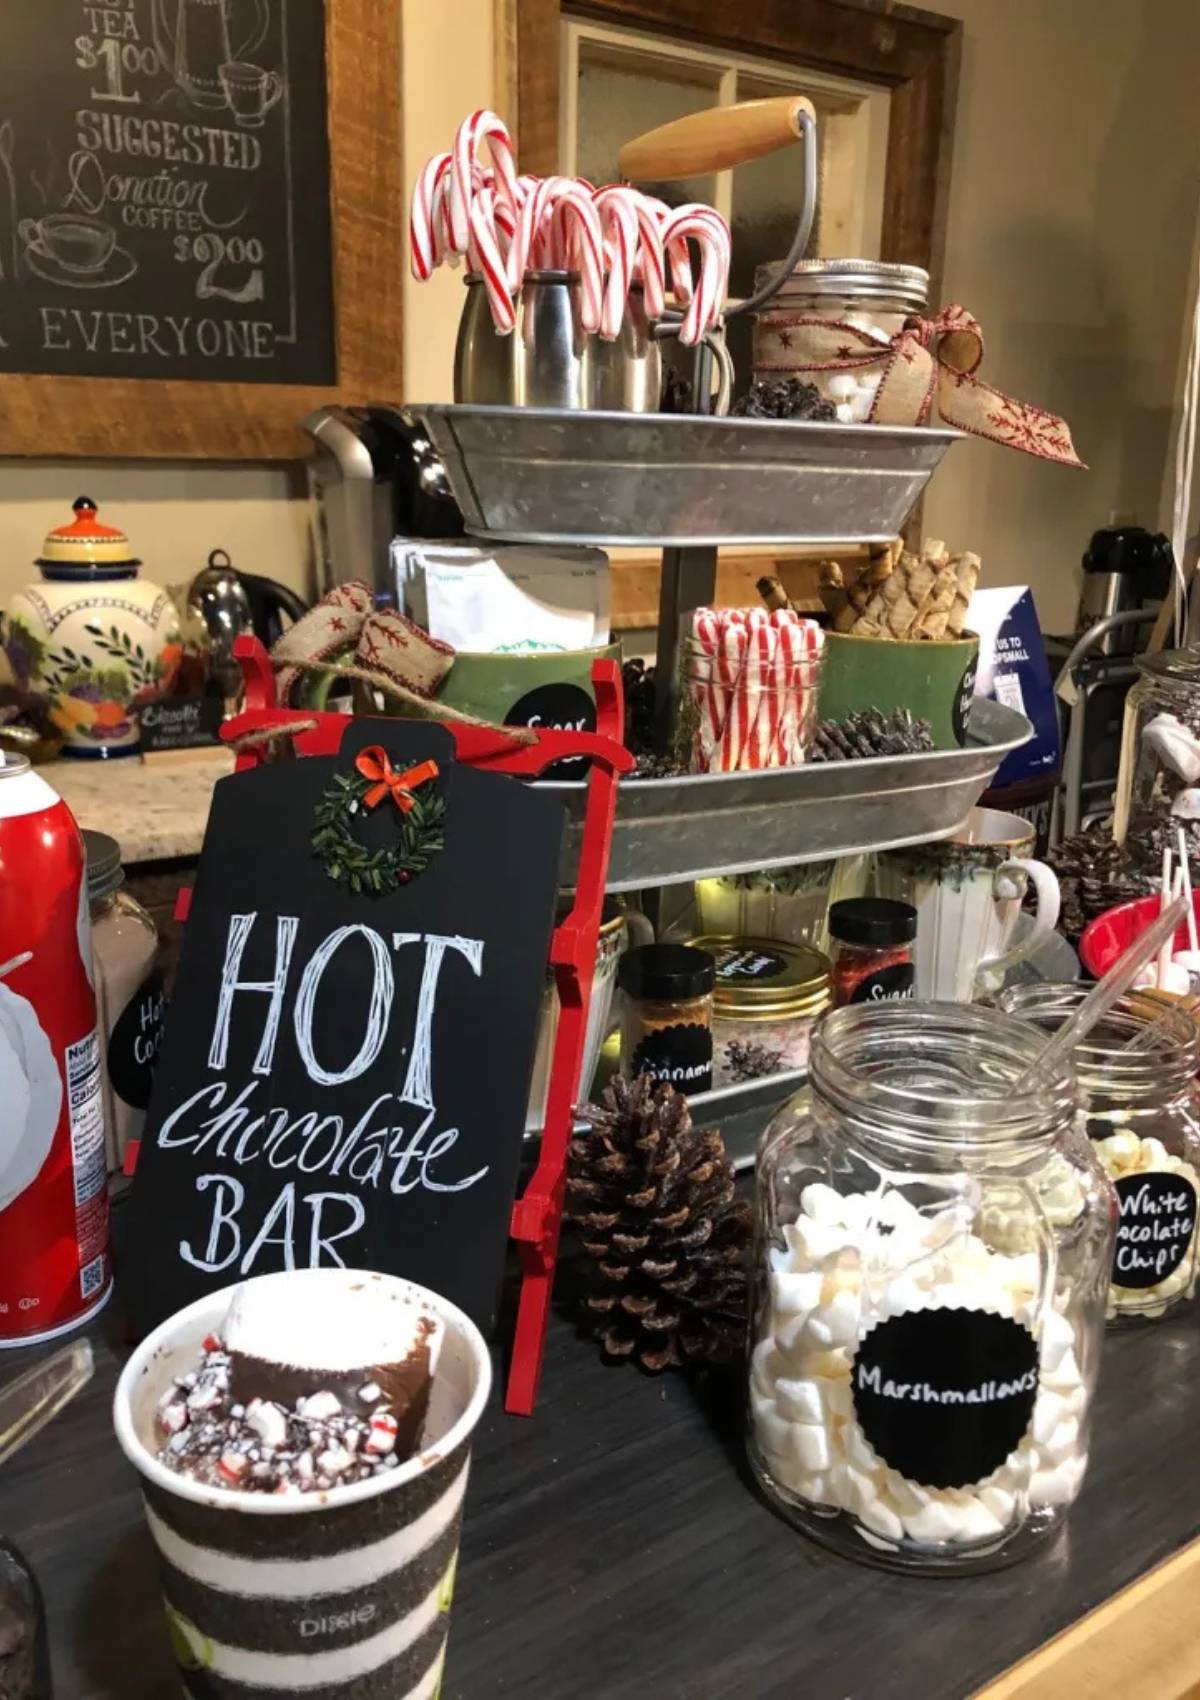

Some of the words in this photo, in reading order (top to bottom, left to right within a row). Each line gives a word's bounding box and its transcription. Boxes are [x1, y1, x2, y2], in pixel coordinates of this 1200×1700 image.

[83, 7, 141, 40] TEA
[76, 110, 262, 171] SUGGESTED
[62, 151, 247, 228] Donation
[121, 204, 202, 232] COFFEE
[40, 307, 275, 358] EVERYONE
[1009, 636, 1021, 648] TO
[208, 911, 485, 1110] HOT
[157, 1079, 490, 1195] Chocolate
[179, 1174, 366, 1275] BAR
[1118, 1183, 1188, 1216] White
[858, 1363, 1037, 1404] Marshmallows
